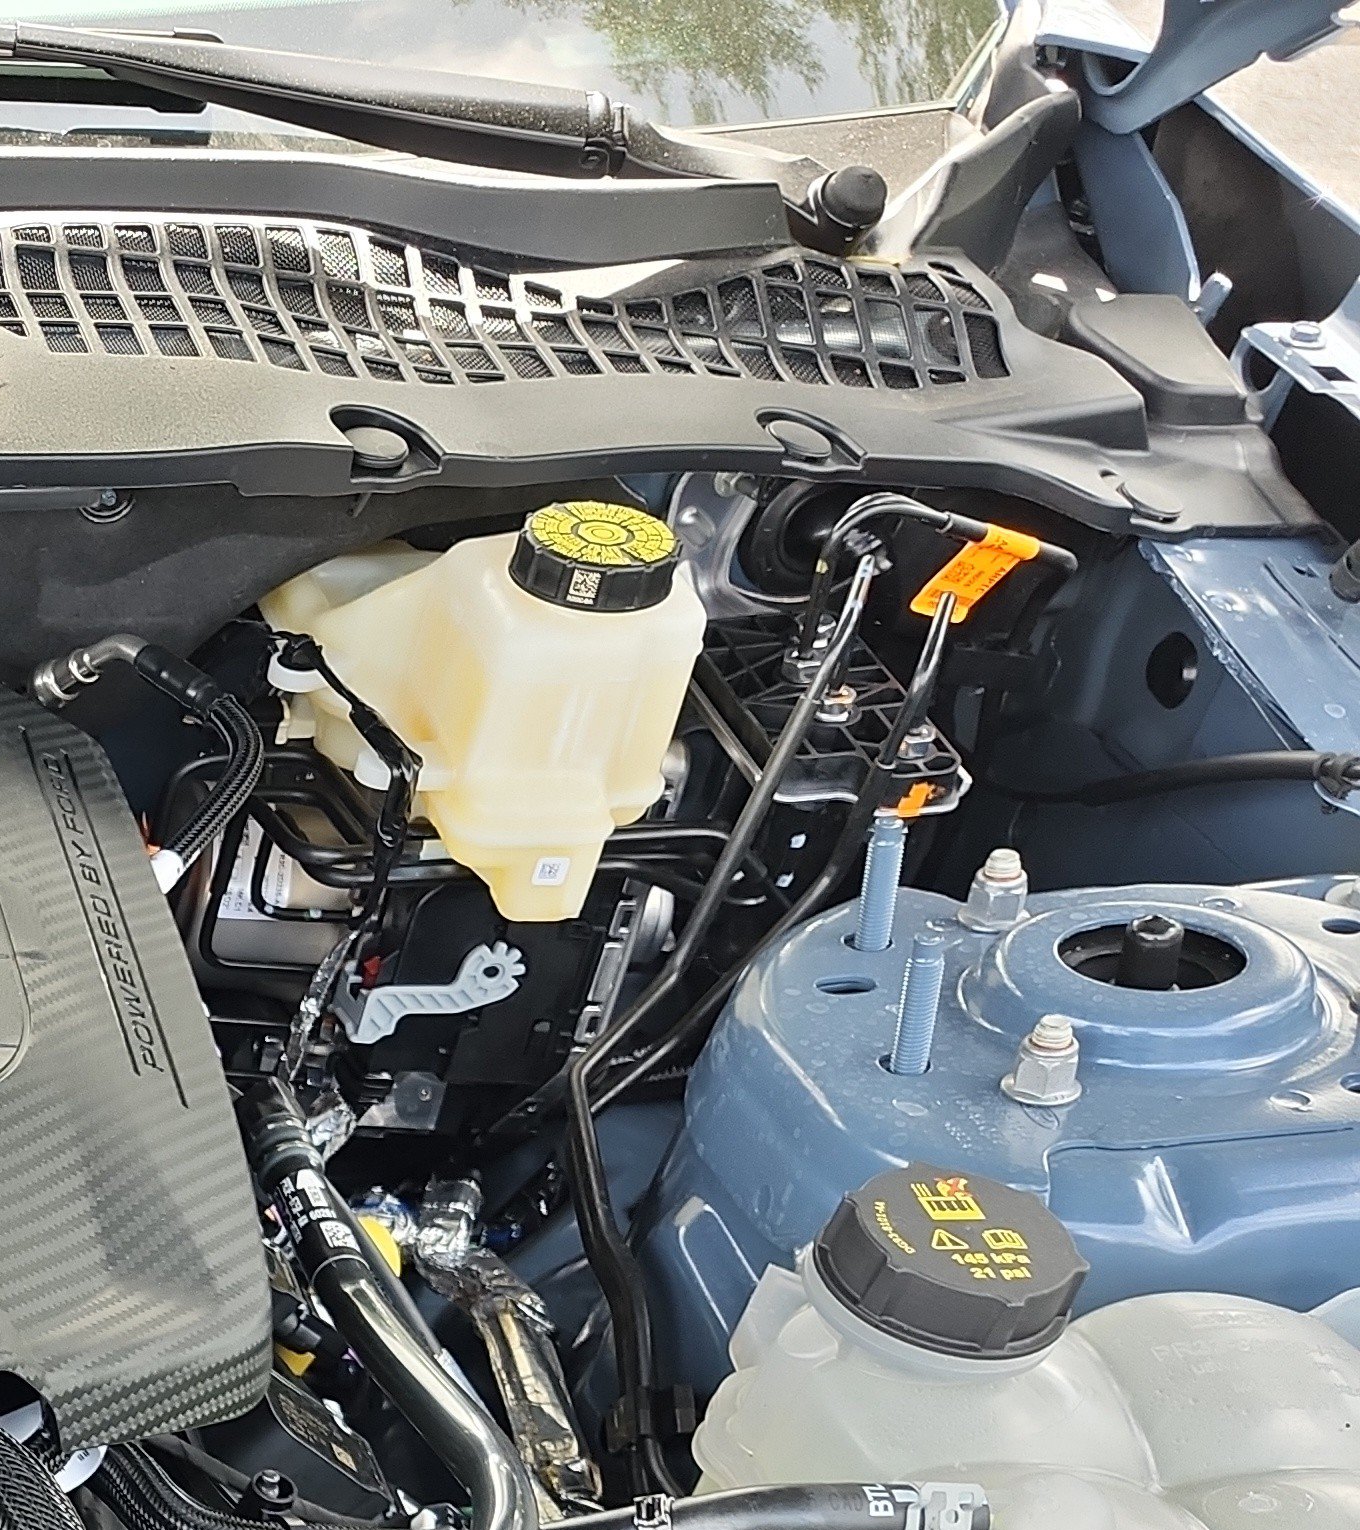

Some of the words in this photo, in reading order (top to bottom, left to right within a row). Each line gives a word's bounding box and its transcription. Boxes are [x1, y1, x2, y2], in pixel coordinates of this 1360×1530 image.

[40, 754, 85, 833] FORD
[71, 841, 102, 884] BY
[90, 895, 164, 1071] POWERED
[951, 1252, 989, 1265] 145
[989, 1252, 1032, 1265] kPa
[970, 1267, 997, 1279] 21
[1000, 1267, 1032, 1281] psi
